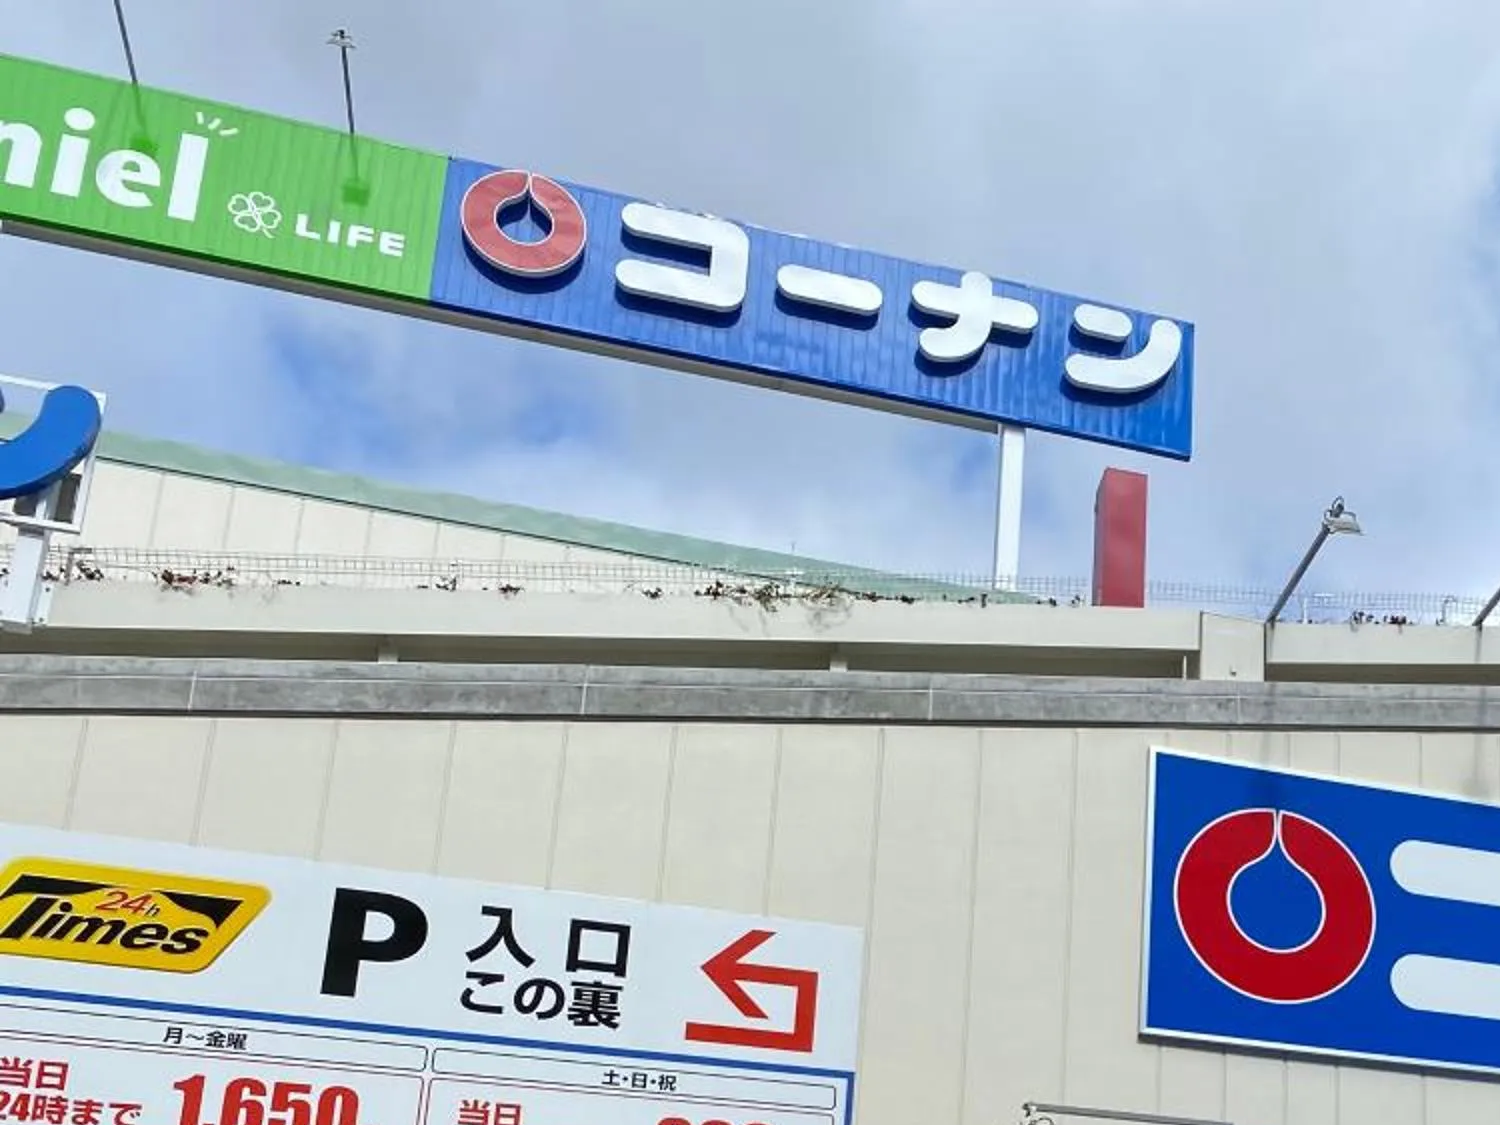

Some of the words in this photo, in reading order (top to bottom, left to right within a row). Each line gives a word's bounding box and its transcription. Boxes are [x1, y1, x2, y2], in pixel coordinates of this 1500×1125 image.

[295, 213, 406, 257] LIFE
[615, 202, 1181, 393] コーナン
[0, 896, 209, 955] Times
[95, 891, 161, 917] 24h
[320, 887, 428, 998] P
[465, 905, 631, 978] 入口
[460, 970, 624, 1030] この裏
[0, 1058, 69, 1090] 当日
